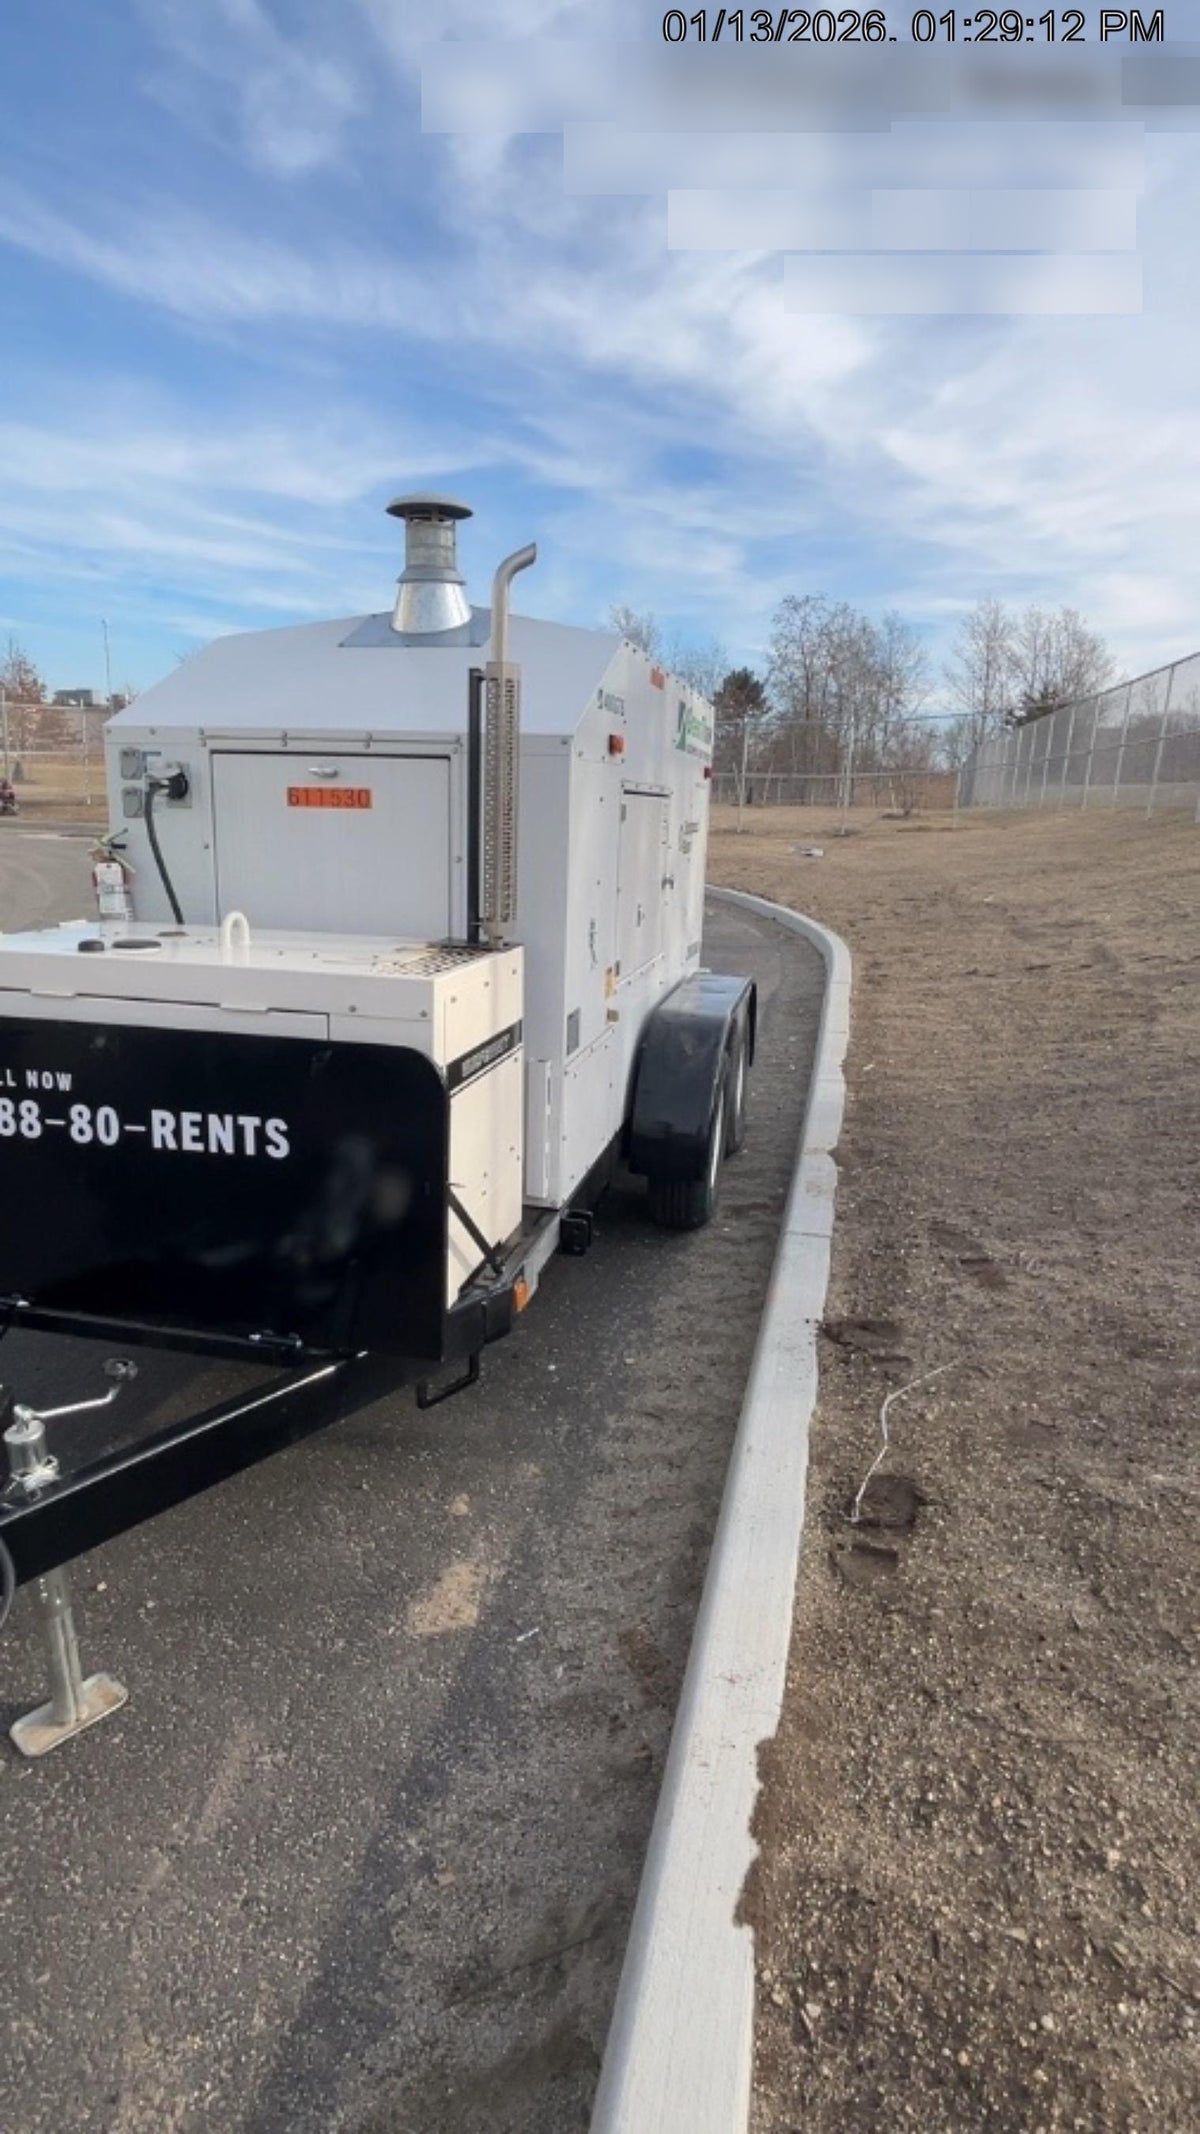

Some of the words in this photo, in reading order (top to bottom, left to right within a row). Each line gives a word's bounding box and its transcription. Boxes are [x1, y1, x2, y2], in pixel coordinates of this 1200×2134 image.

[0, 1068, 17, 1087] L
[25, 1069, 72, 1092] NOW
[0, 1097, 290, 1159] 88-80-RENTS
